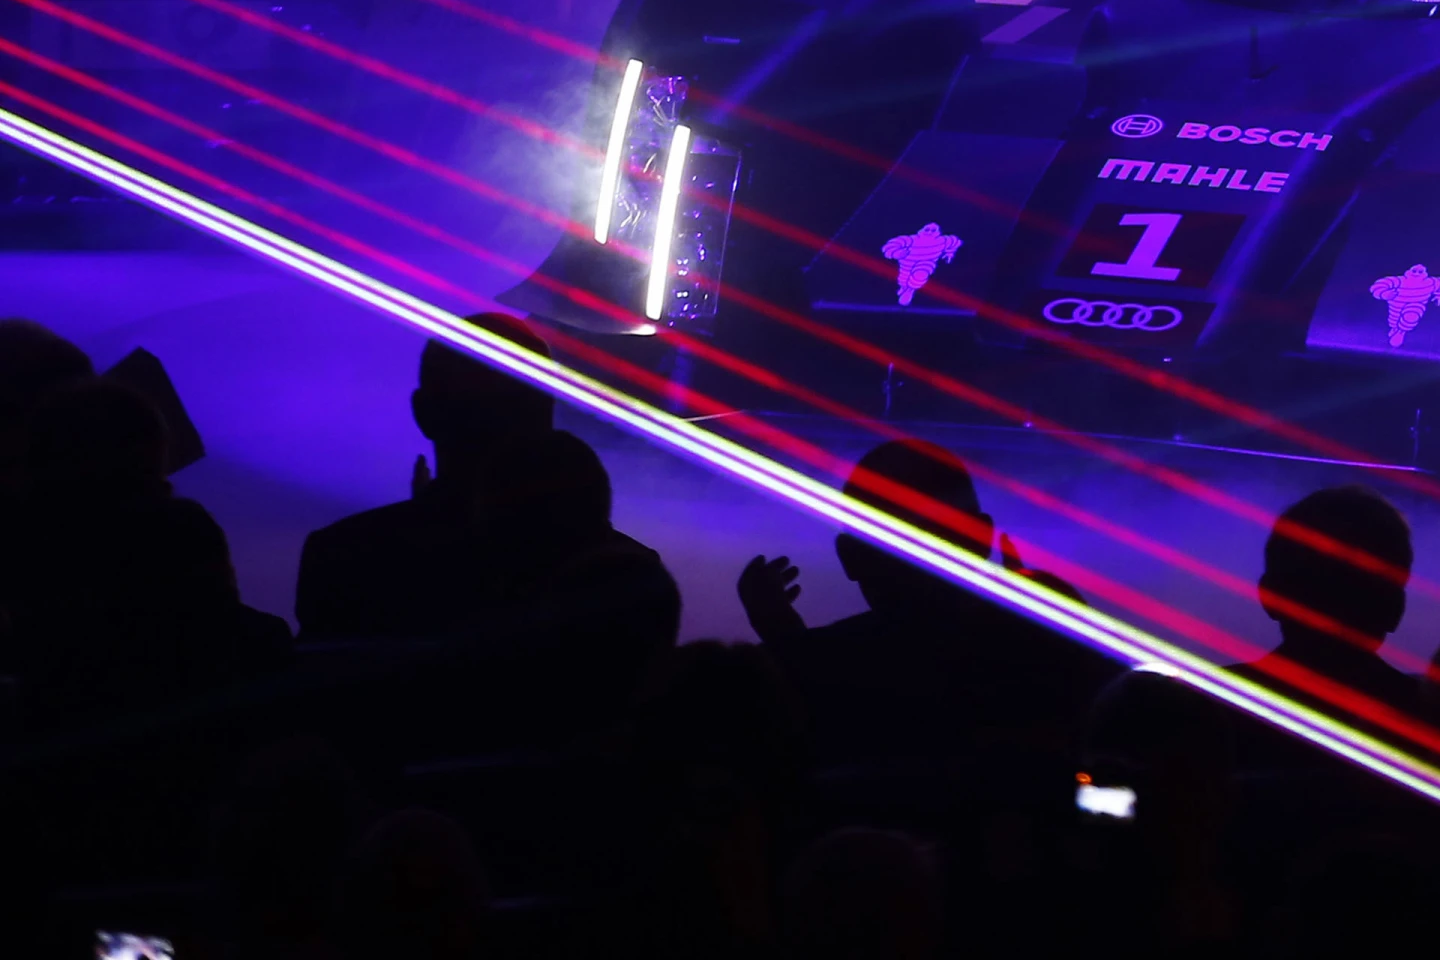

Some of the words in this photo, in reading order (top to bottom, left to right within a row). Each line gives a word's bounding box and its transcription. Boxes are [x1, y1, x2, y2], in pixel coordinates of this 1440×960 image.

[1177, 122, 1333, 151] BOSCH
[1098, 158, 1290, 192] MAHLE
[1090, 213, 1183, 281] 1
